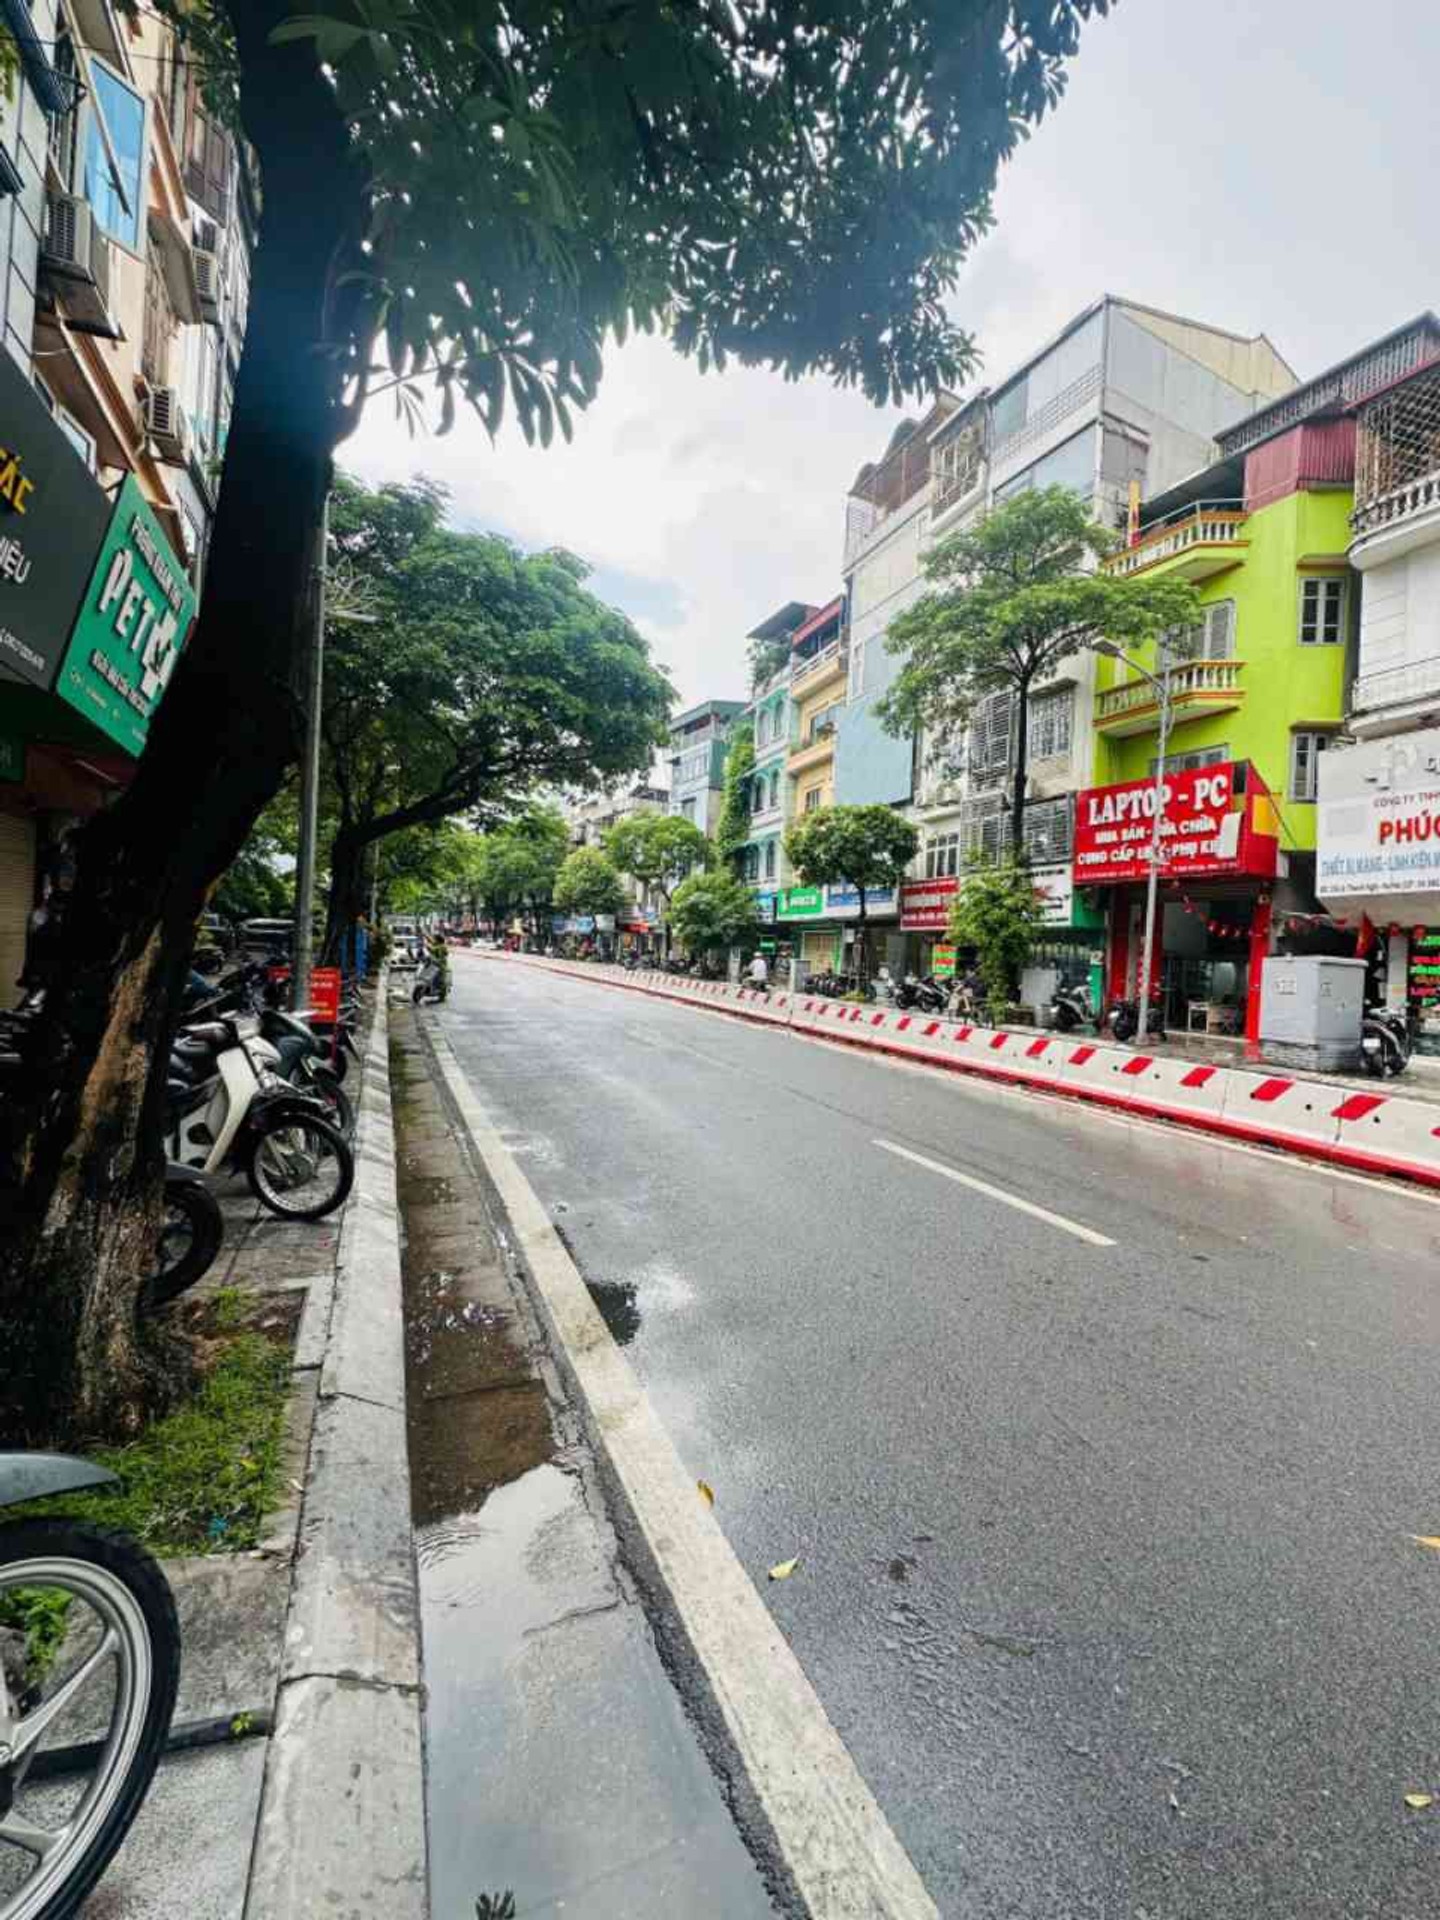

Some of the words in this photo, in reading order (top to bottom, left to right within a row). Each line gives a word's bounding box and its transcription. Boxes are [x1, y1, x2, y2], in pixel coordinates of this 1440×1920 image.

[98, 547, 156, 652] PET
[1088, 783, 1172, 826] LAPTOP
[1194, 774, 1227, 811] PC
